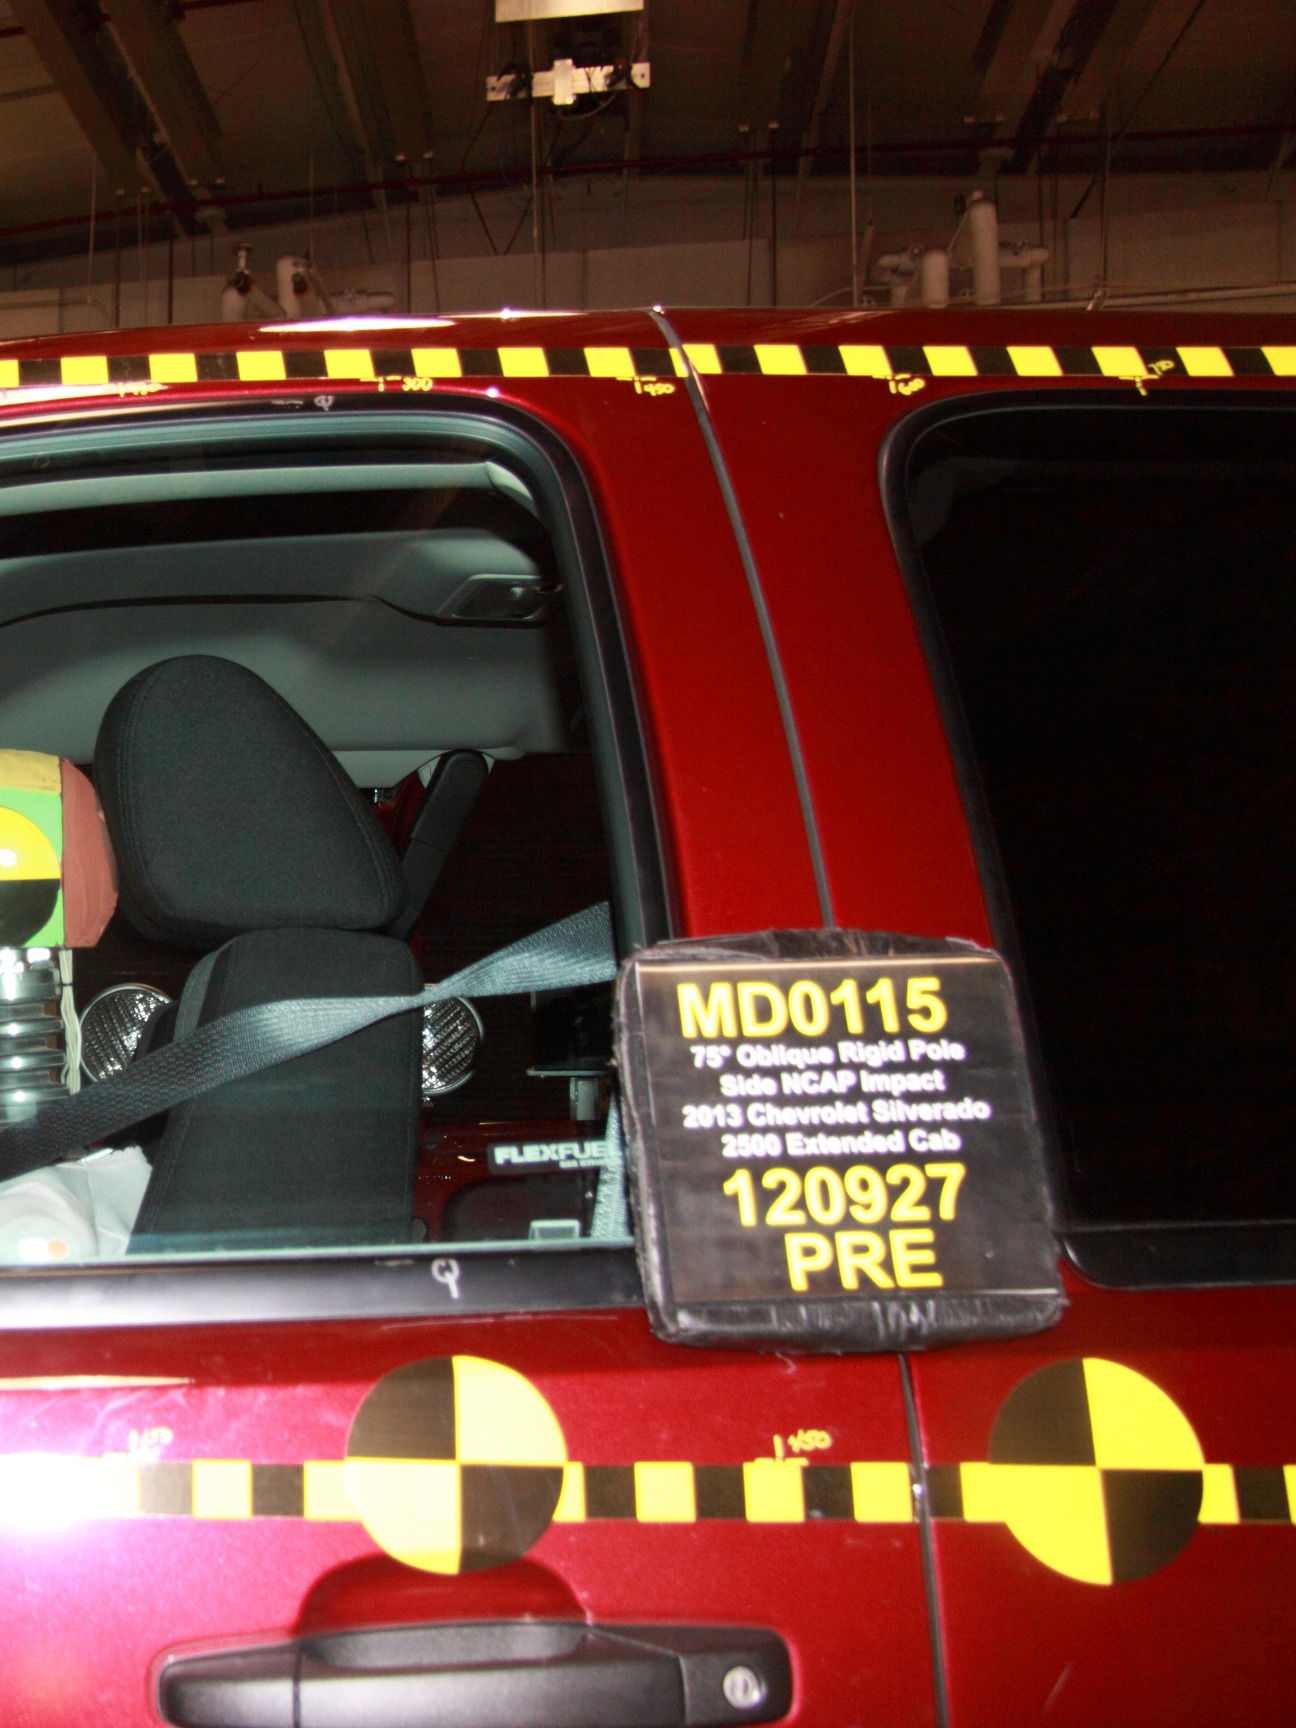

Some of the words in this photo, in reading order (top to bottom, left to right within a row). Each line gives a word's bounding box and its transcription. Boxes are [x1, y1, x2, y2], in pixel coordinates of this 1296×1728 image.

[402, 376, 433, 392] 300
[643, 382, 675, 397] 450
[676, 976, 948, 1038] MD0115
[735, 1043, 835, 1069] Oblique
[837, 1039, 906, 1067] Rigid
[908, 1038, 966, 1062] Pole
[719, 1073, 778, 1097] Side
[780, 1070, 856, 1095] NCAP
[860, 1069, 947, 1097] Impact
[681, 1103, 744, 1129] 2013
[746, 1100, 870, 1127] Chevrolet
[871, 1096, 992, 1123] Silverado
[494, 1140, 608, 1165] FLEXFUE
[720, 1132, 783, 1158] 2500
[784, 1129, 906, 1157] Extended
[907, 1127, 963, 1152] Cab
[722, 1162, 966, 1227] 120927
[783, 1228, 944, 1291] PRE
